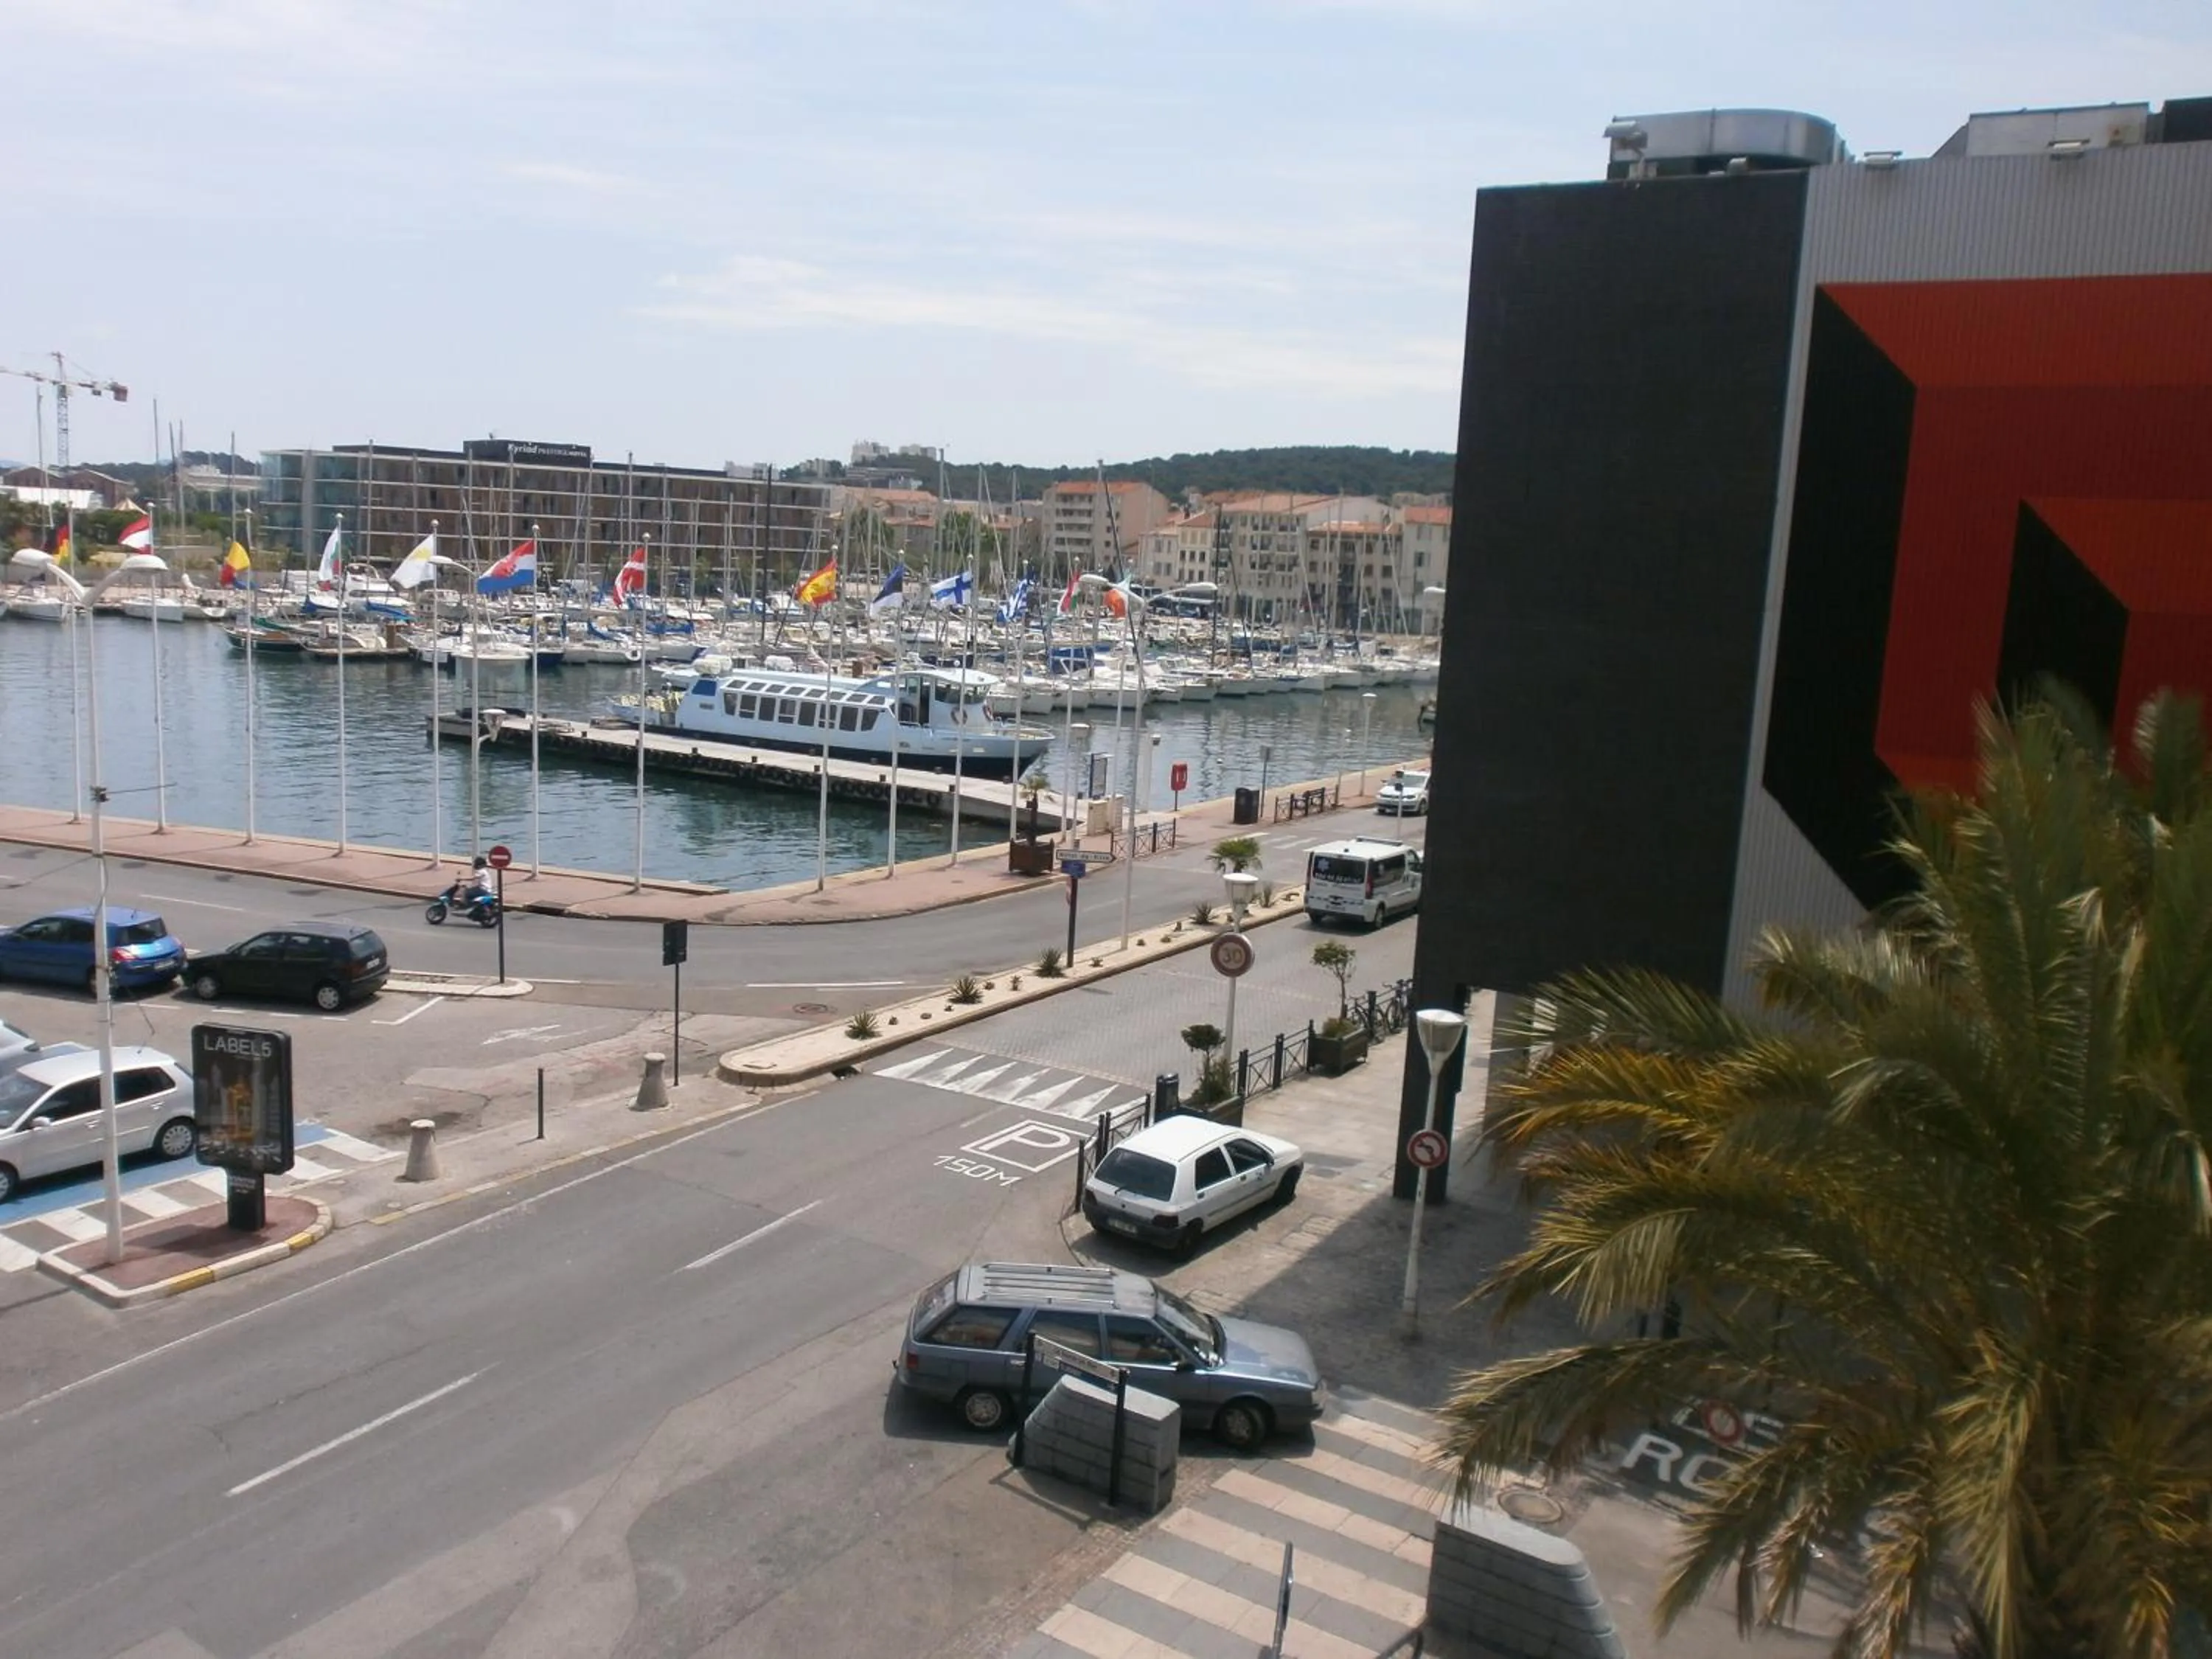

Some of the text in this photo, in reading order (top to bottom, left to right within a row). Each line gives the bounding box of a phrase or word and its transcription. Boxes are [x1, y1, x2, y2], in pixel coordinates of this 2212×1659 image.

[1222, 947, 1243, 964] 30
[978, 1124, 1071, 1152] P
[933, 1155, 1023, 1186] 150M
